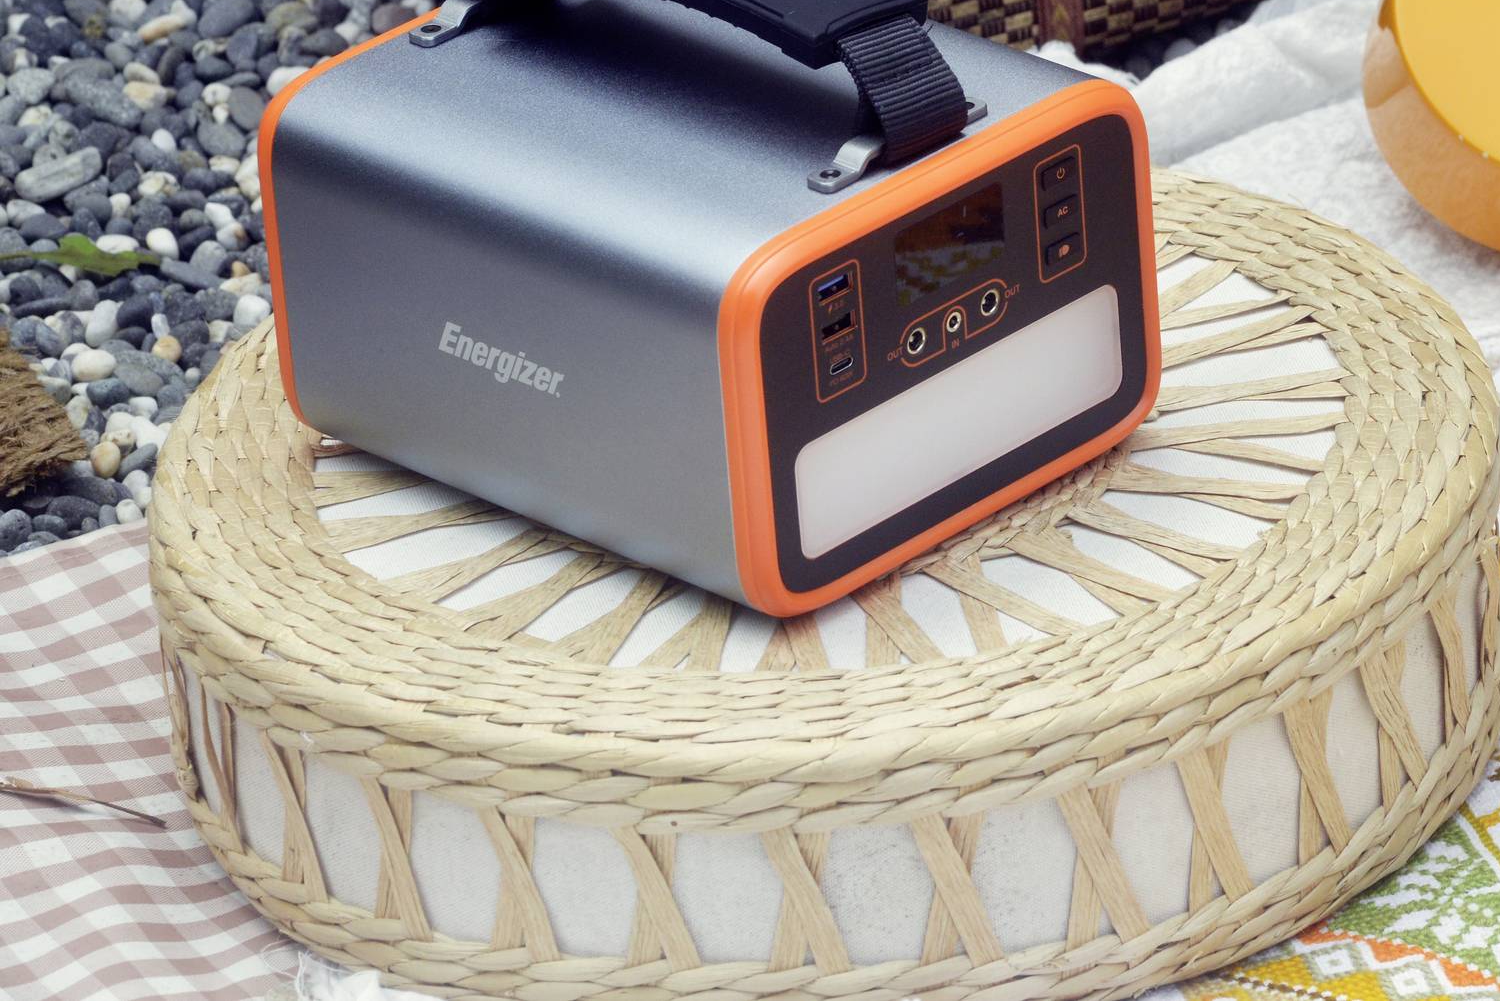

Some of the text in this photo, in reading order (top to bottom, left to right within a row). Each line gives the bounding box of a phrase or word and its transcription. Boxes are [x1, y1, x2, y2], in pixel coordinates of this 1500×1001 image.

[1057, 206, 1069, 218] AC
[1004, 284, 1020, 298] OUT
[951, 339, 960, 349] IN
[438, 321, 565, 398] Energizer
[887, 346, 903, 361] OUT
